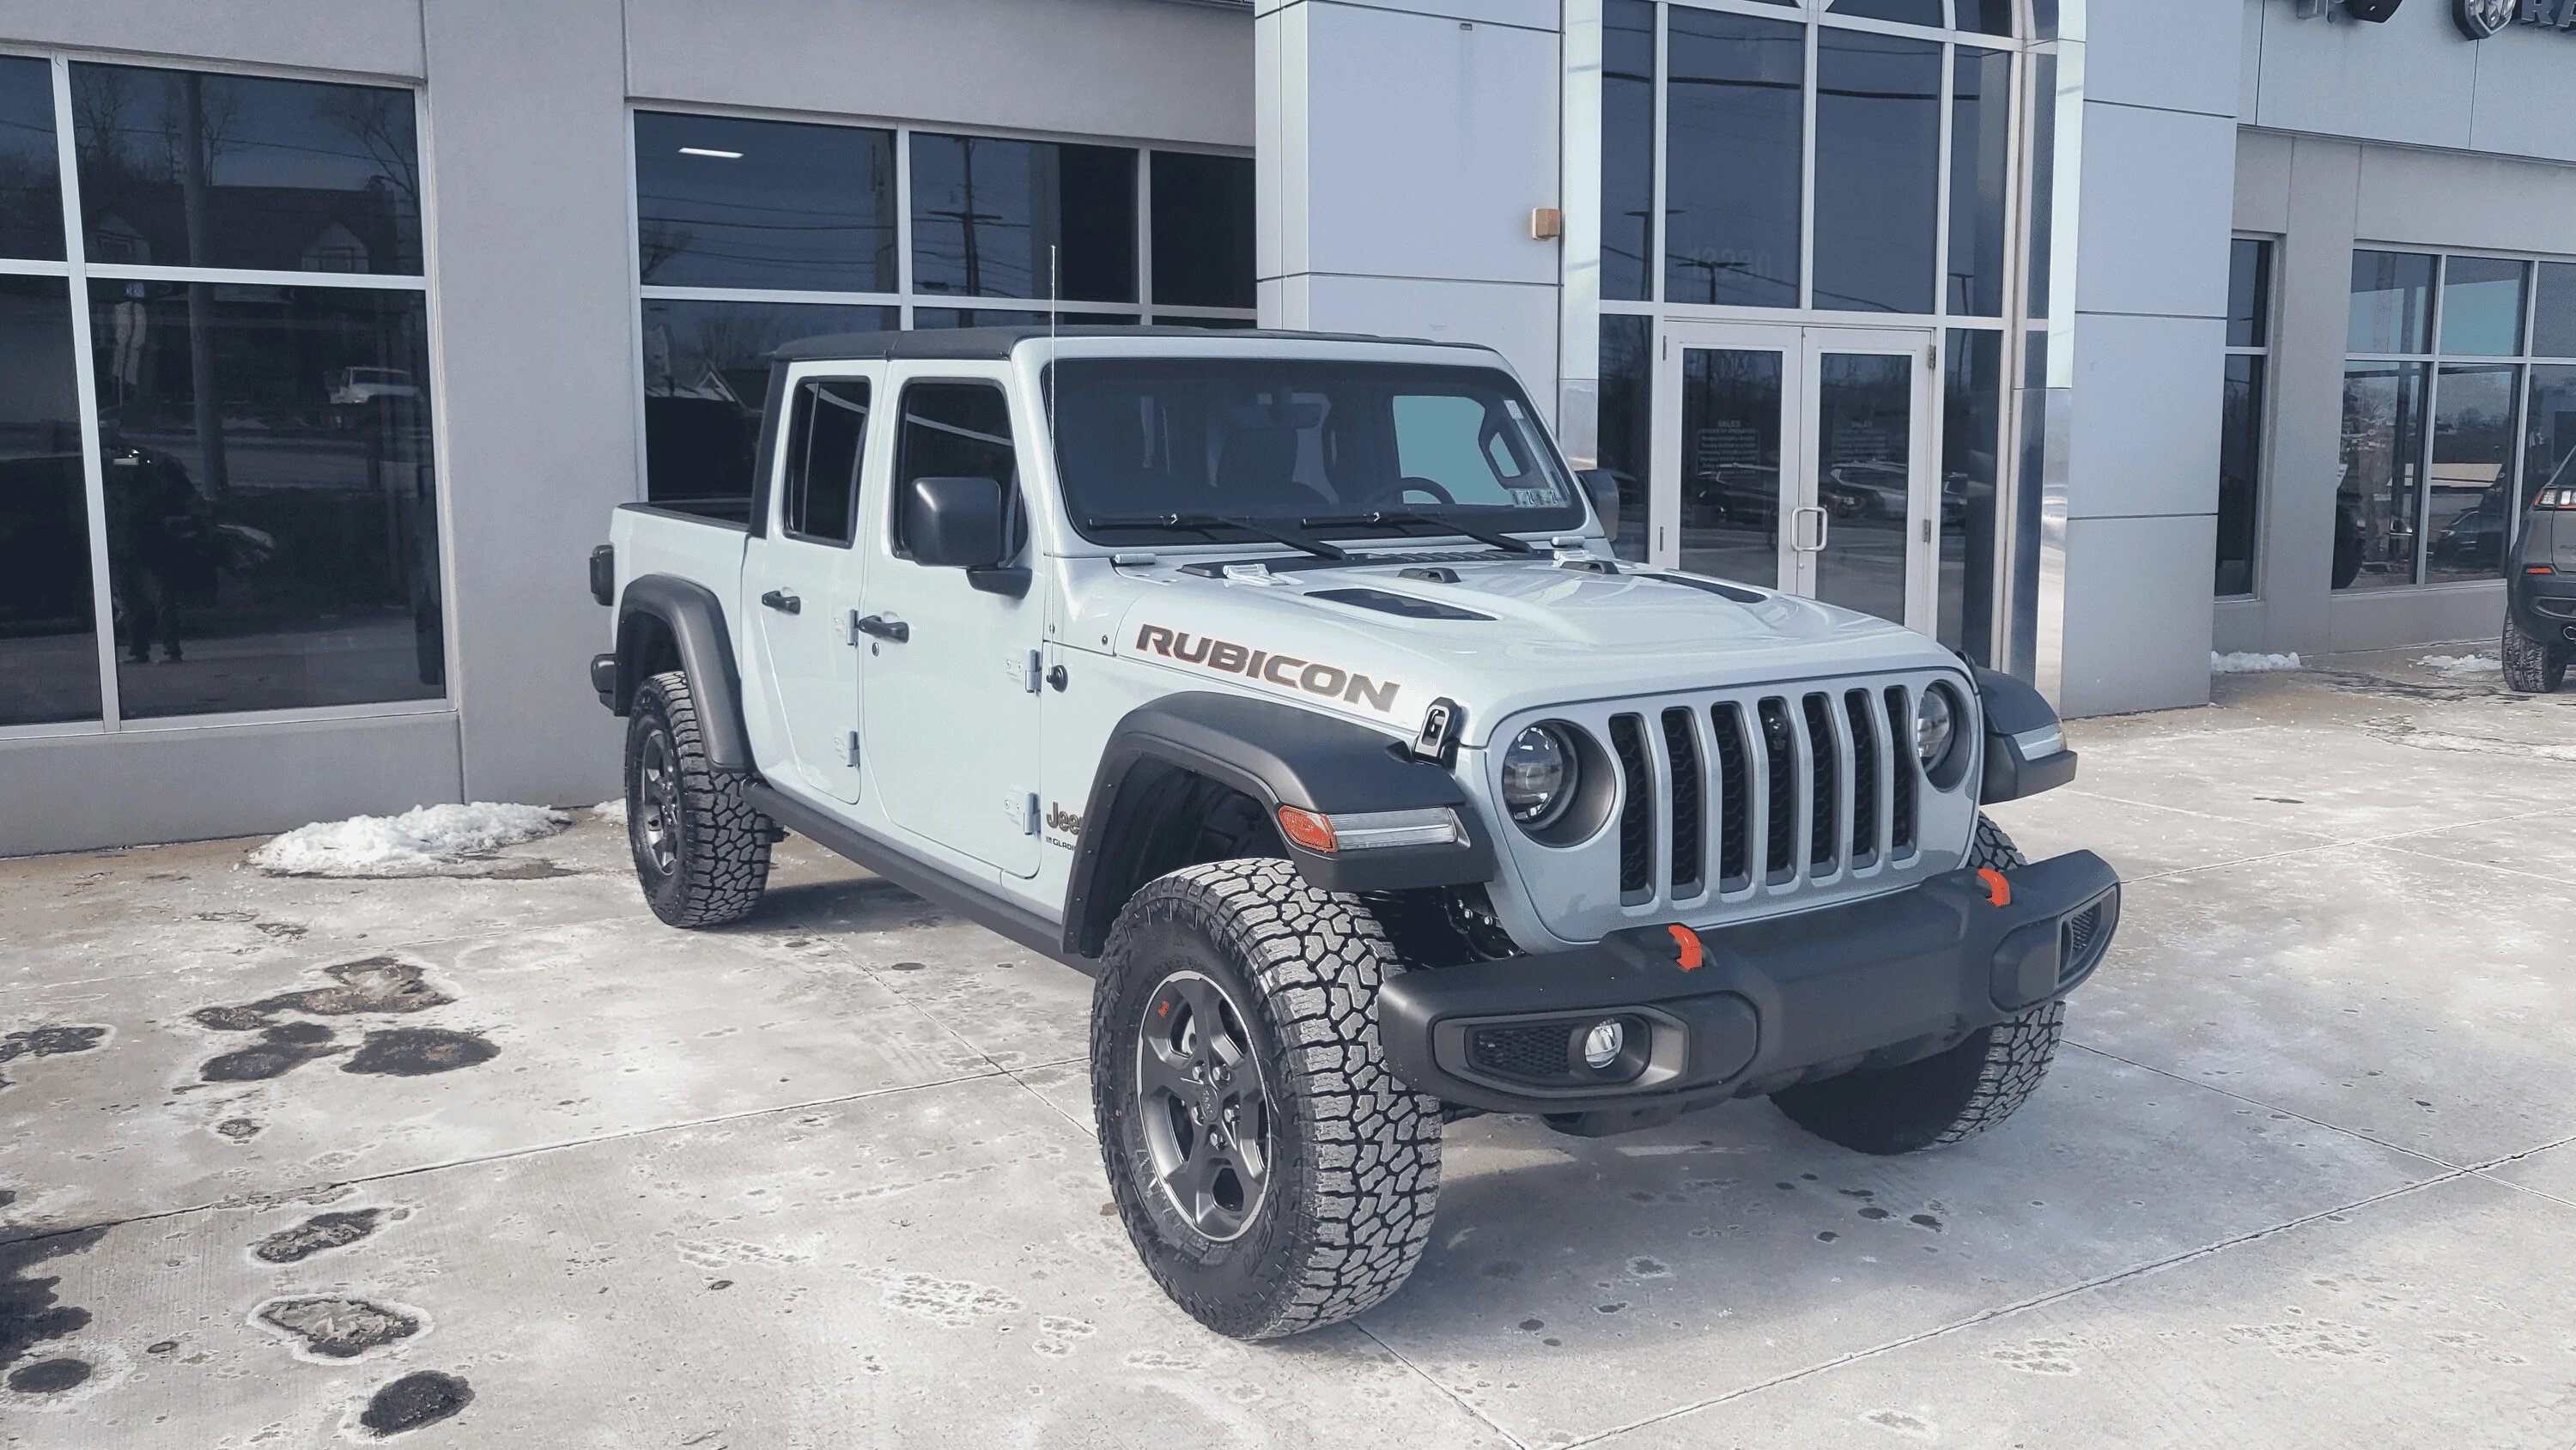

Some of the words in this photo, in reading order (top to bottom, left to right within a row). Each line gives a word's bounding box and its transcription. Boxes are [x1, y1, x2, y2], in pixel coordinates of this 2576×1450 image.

[1136, 624, 1401, 713] RUBICON
[1047, 802, 1083, 835] Jee
[1053, 839, 1077, 851] GLADI
